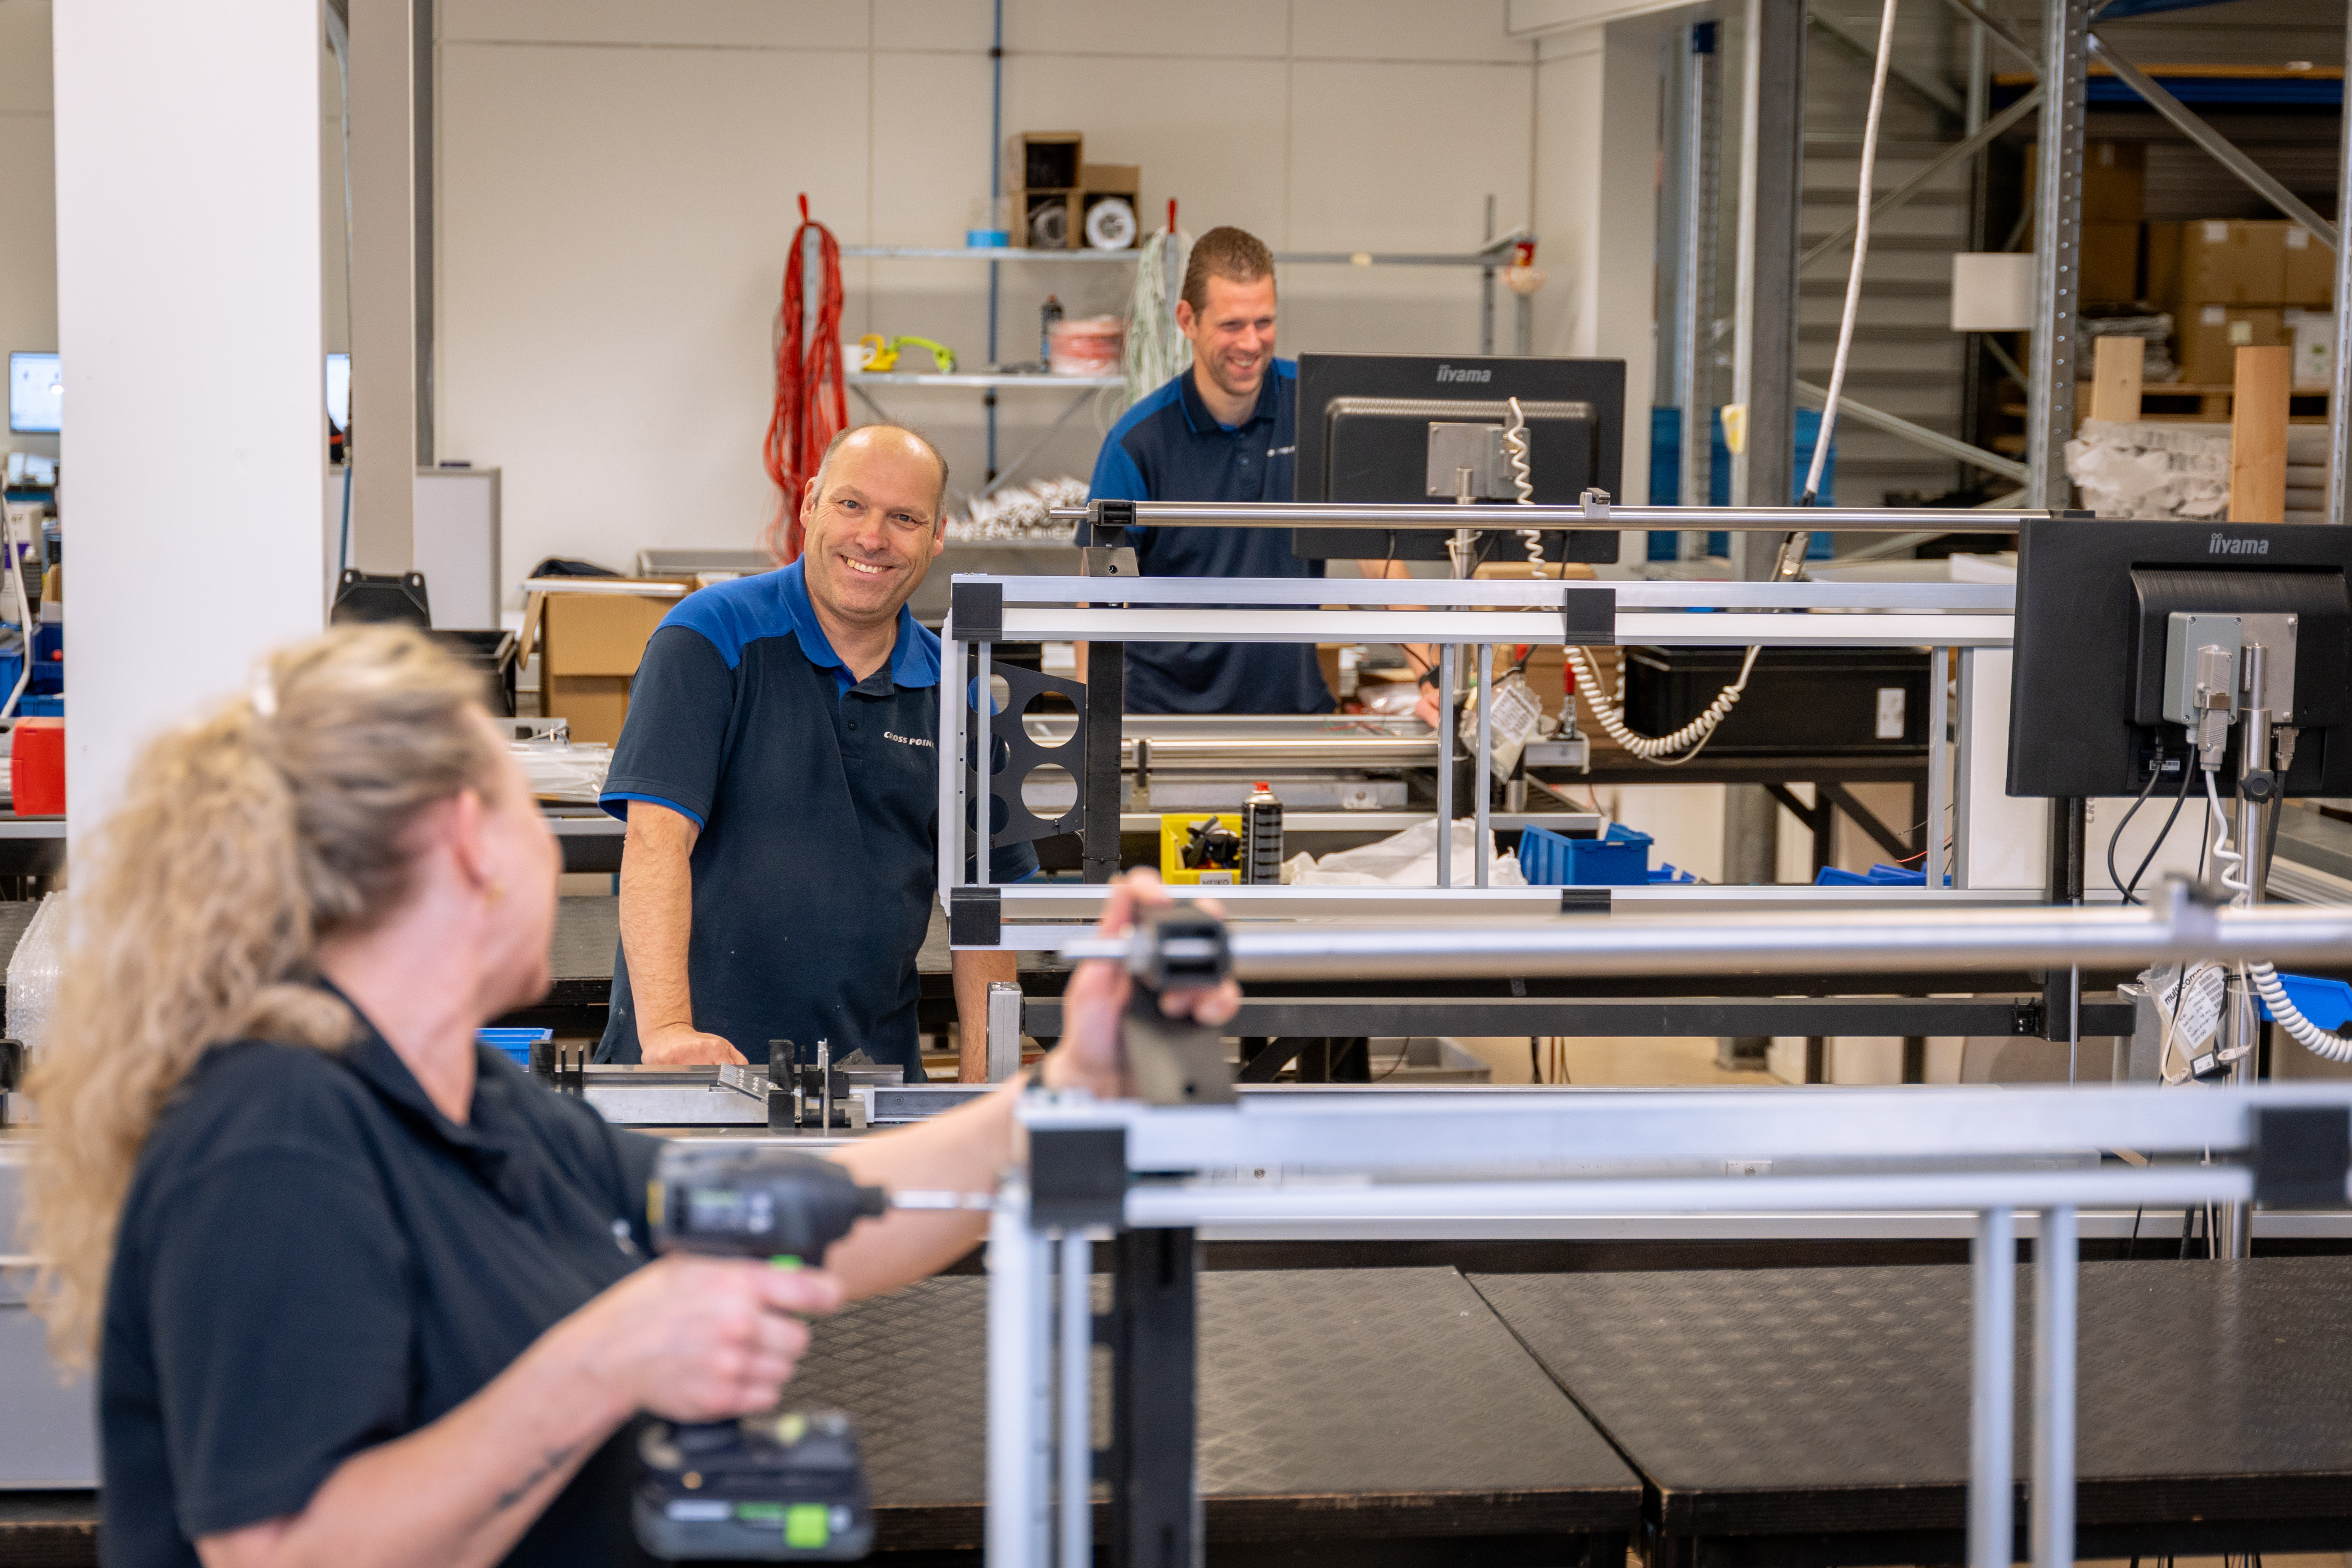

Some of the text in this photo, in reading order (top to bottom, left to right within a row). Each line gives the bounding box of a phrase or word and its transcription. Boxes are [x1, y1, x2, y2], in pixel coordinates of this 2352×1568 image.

[1437, 364, 1492, 381] iiyama
[2209, 533, 2269, 554] iiyama
[884, 731, 907, 743] CROSS
